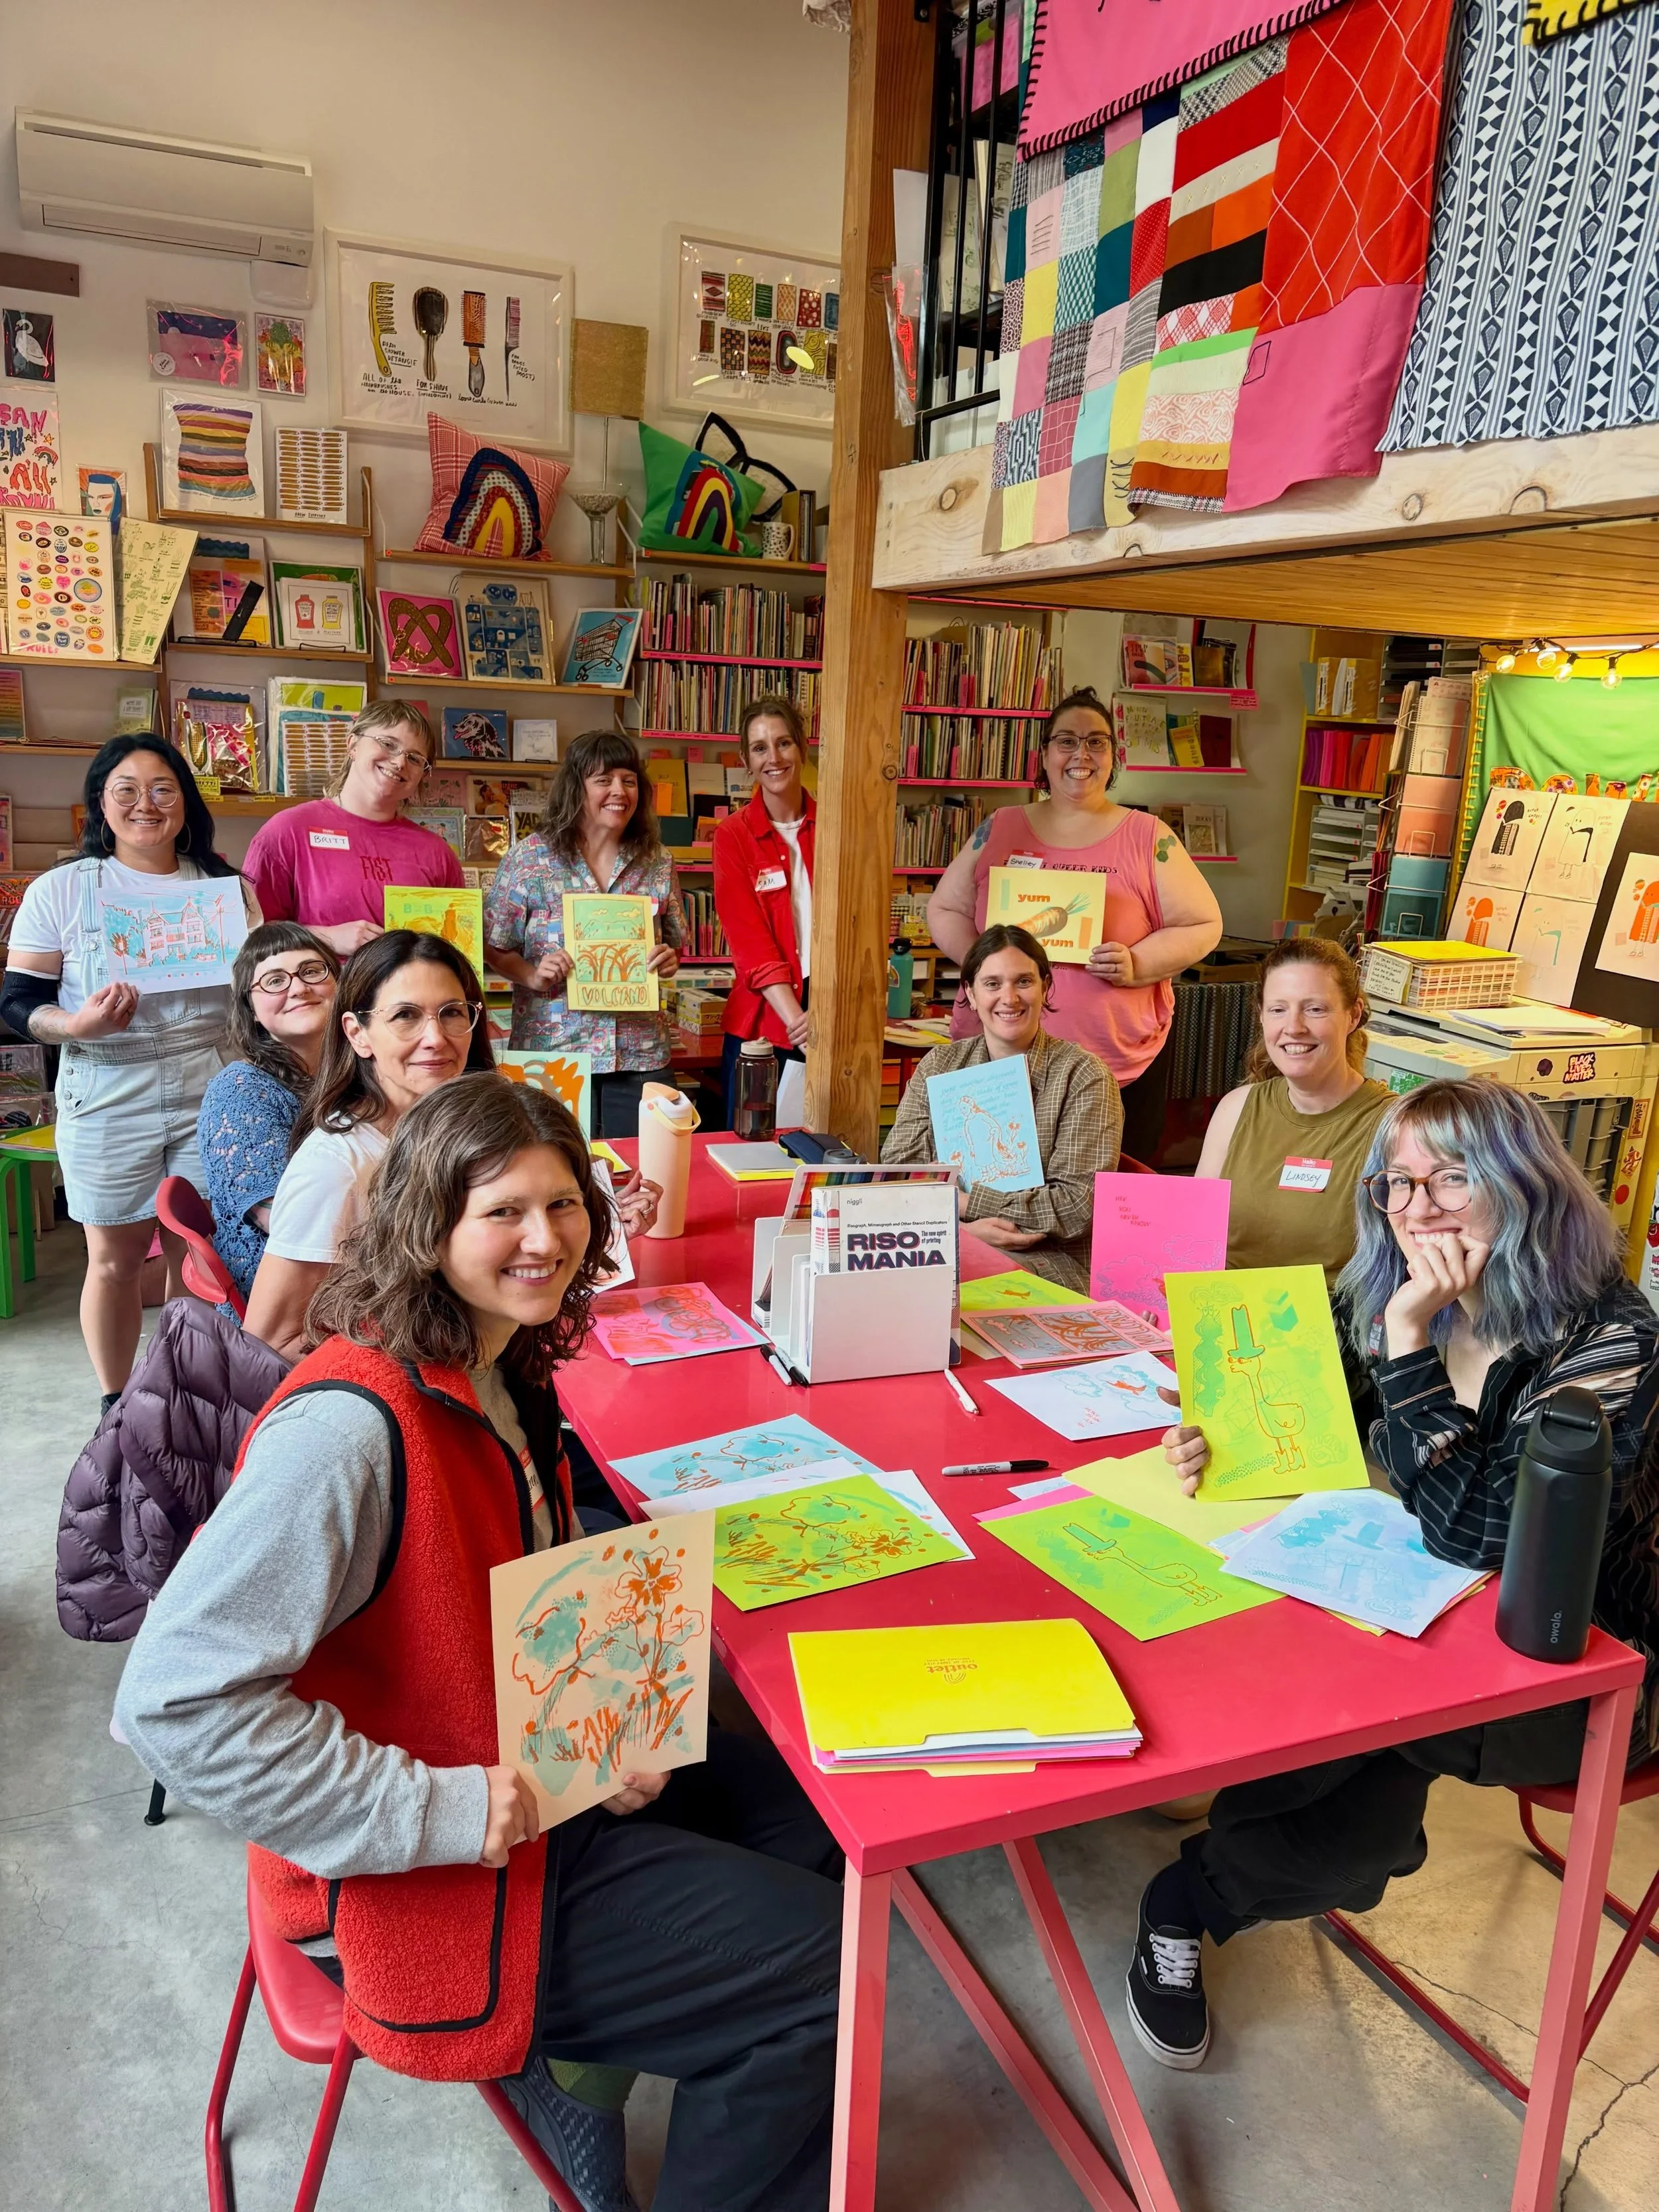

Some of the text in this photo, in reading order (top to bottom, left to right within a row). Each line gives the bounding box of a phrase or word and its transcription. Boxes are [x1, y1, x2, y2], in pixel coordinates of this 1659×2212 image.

[388, 356, 417, 366] DETANGLE
[363, 373, 375, 382] ALL
[516, 371, 535, 381] MOST)
[416, 379, 449, 392] FOR SHINE
[314, 835, 346, 844] BRITT
[359, 855, 394, 882] FIST
[1052, 863, 1088, 873] QUEER
[758, 878, 775, 889] SAM
[1018, 893, 1050, 903] yum
[1041, 938, 1074, 948] yum
[581, 986, 648, 1006] VOLCANO
[1569, 1054, 1594, 1066] BLACK
[1569, 1064, 1591, 1072] LIVES
[1565, 1069, 1594, 1081] MATTER
[1285, 1170, 1322, 1187] LINDSEY
[847, 1231, 920, 1252] RISO
[847, 1250, 946, 1271] MANIA
[926, 1663, 978, 1674] outlet
